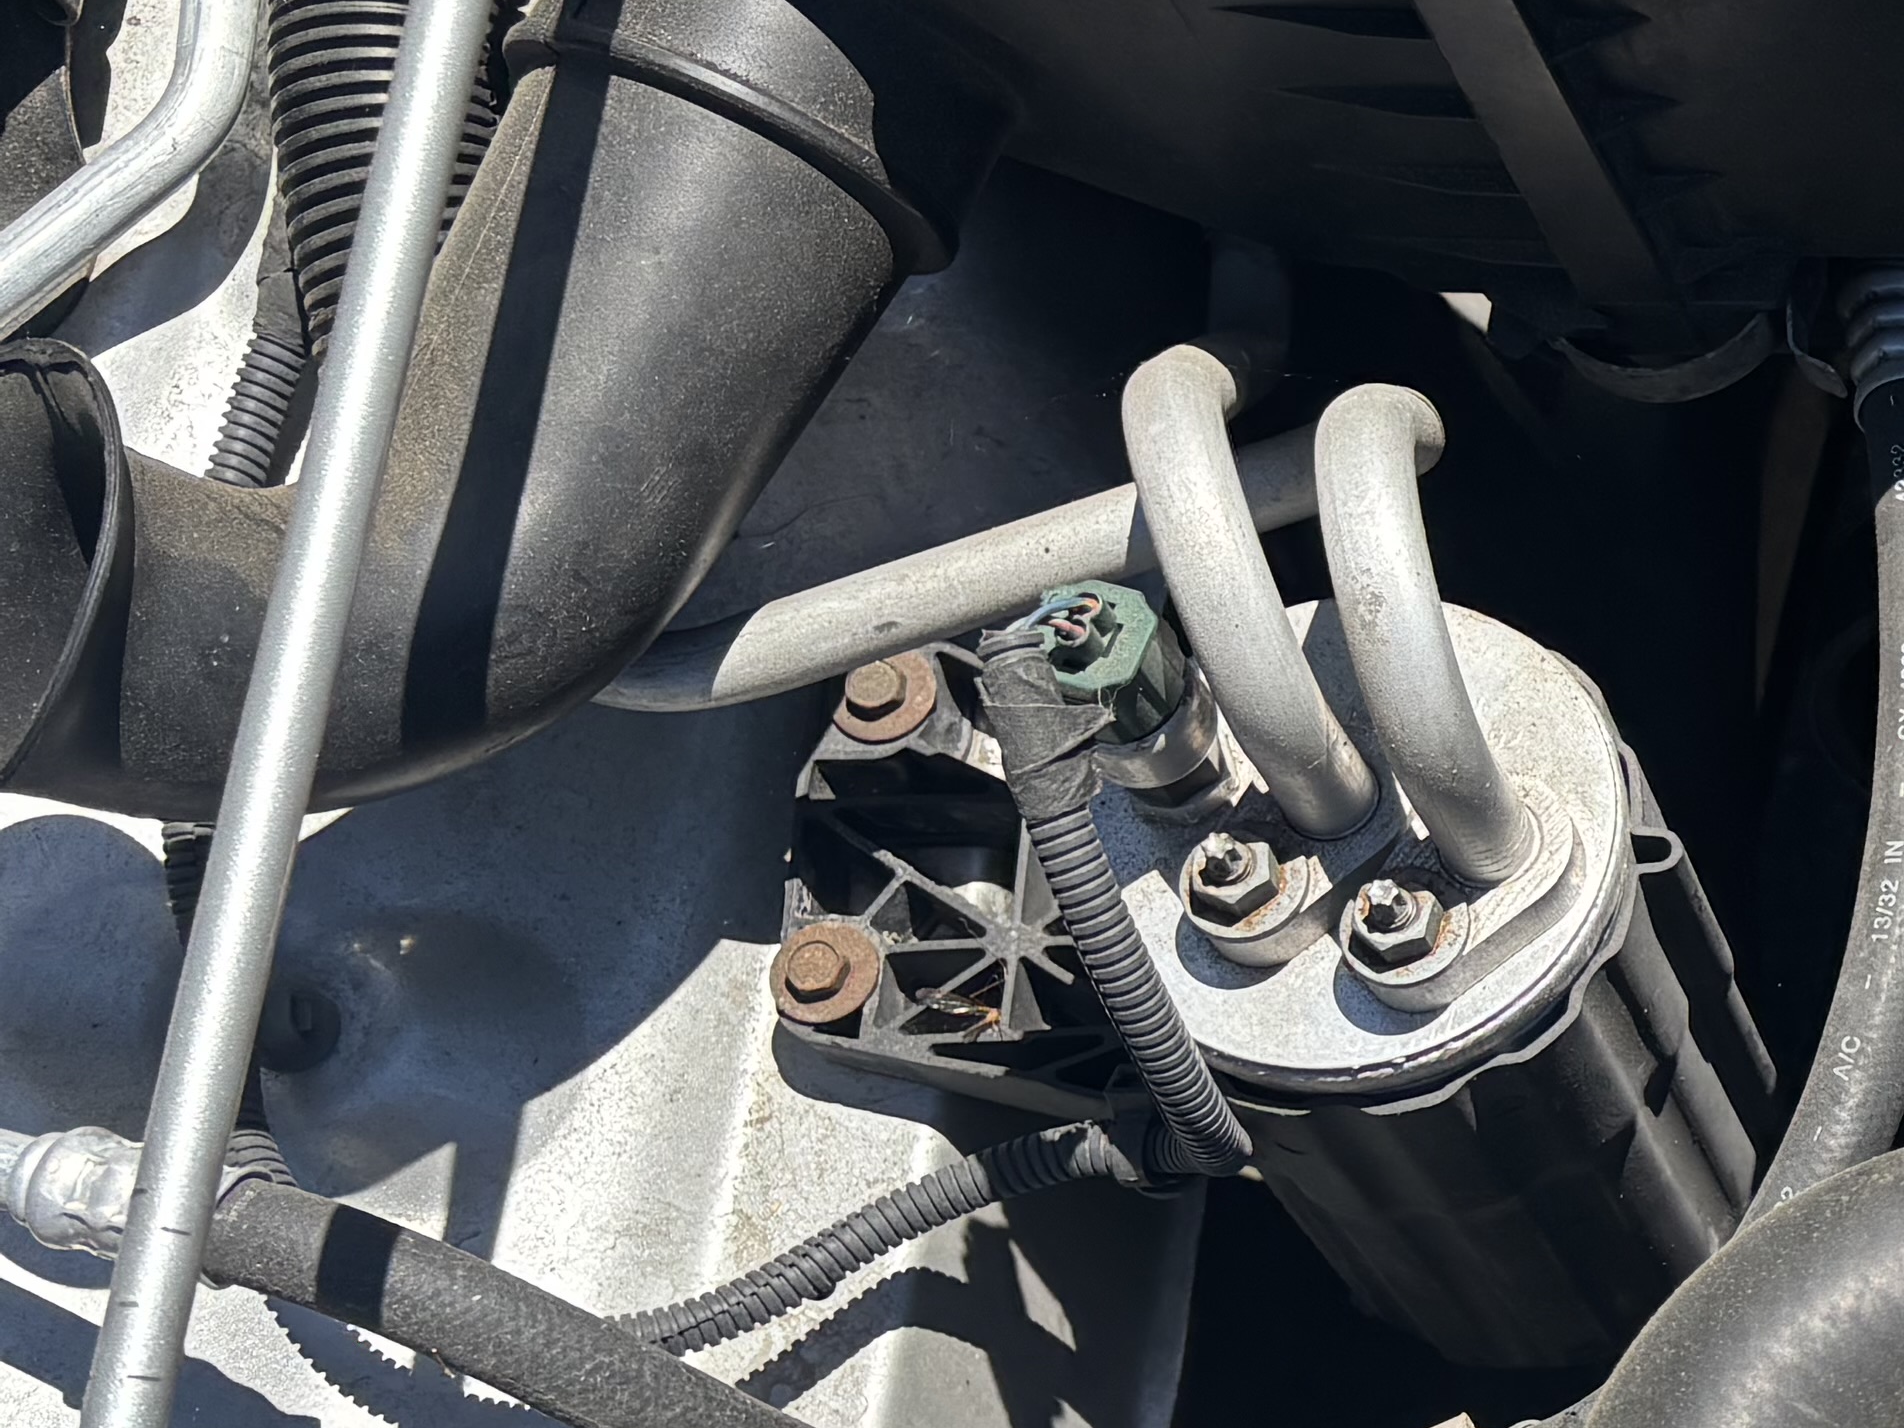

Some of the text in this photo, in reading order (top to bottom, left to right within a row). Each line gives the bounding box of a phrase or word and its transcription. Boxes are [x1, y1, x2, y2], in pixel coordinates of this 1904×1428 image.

[1884, 840, 1904, 864] IN
[1871, 879, 1900, 942] 13/32
[1832, 1035, 1861, 1081] A/C
